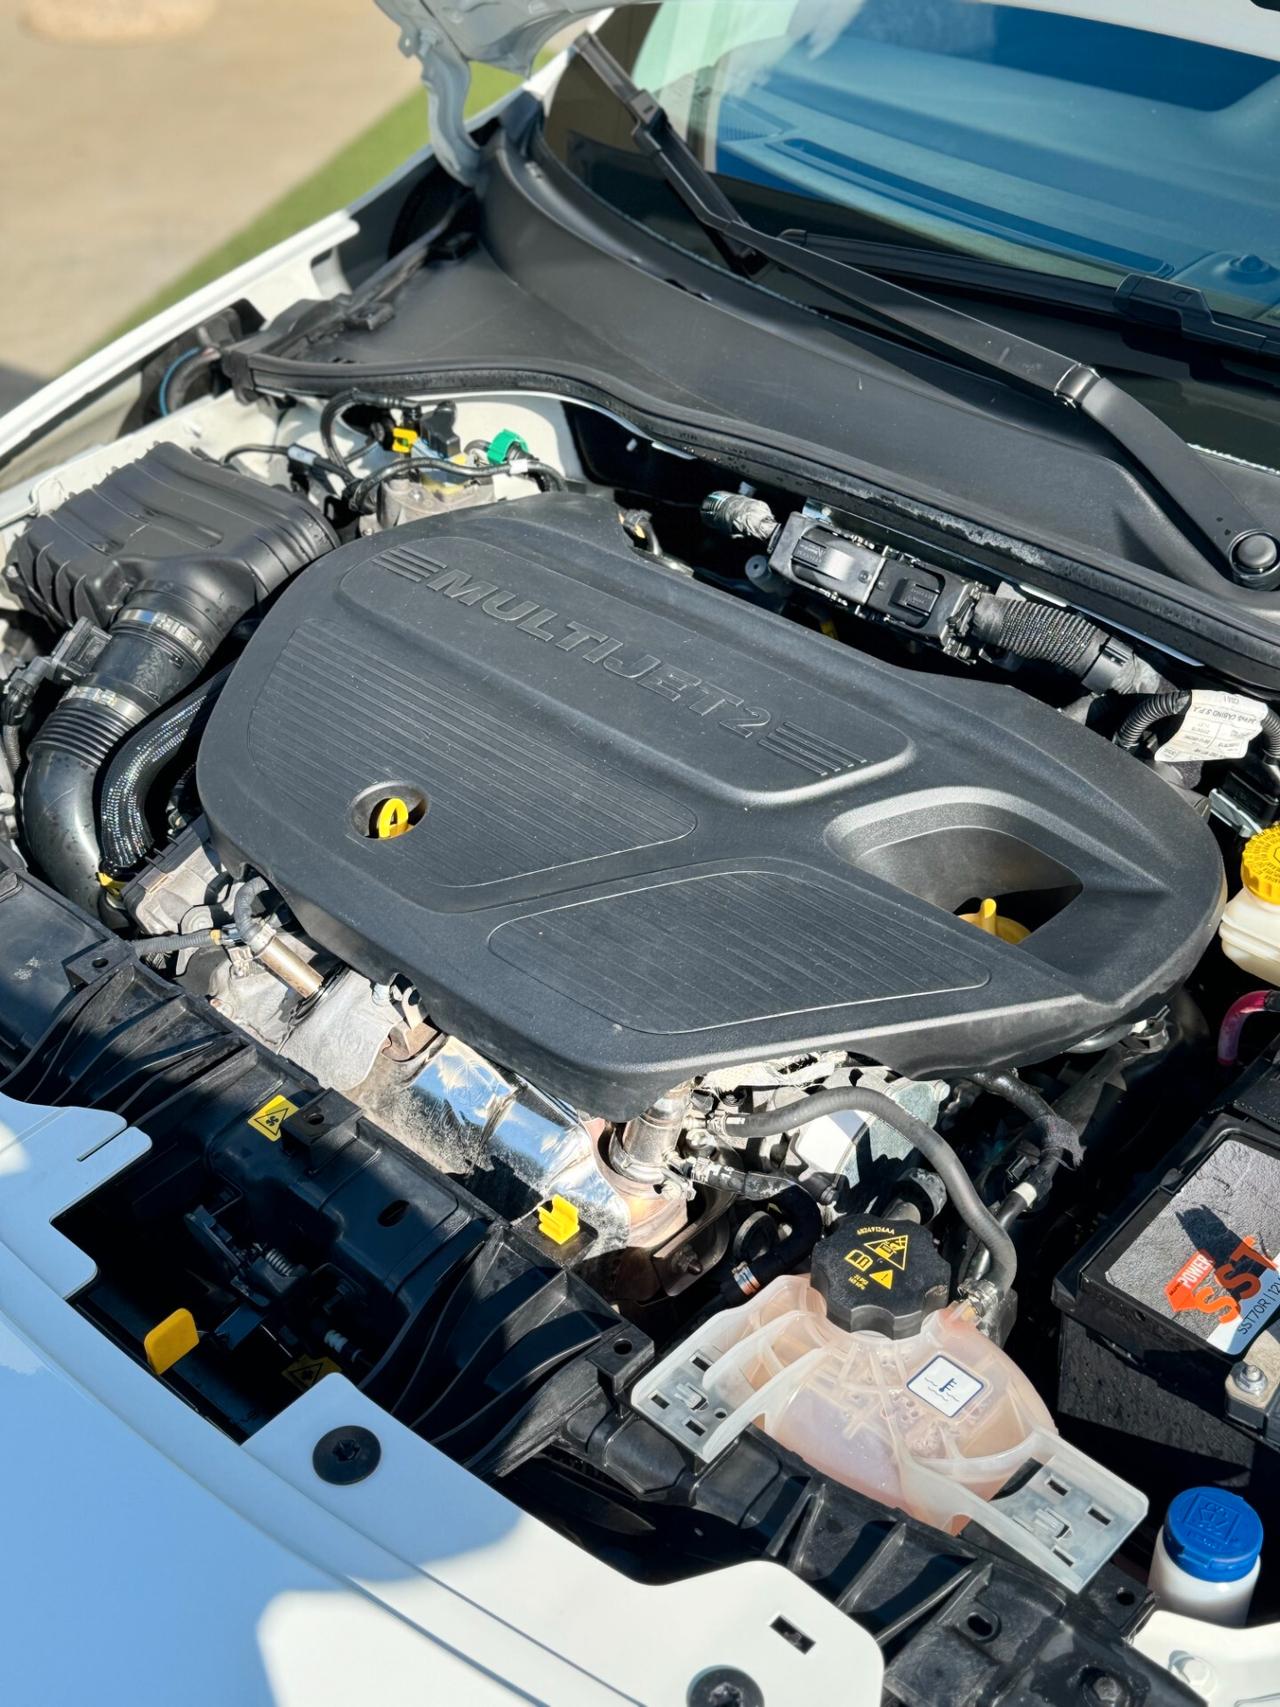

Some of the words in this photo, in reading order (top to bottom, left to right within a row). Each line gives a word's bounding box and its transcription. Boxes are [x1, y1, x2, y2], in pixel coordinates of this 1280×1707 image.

[1177, 1253, 1216, 1289] POWER
[1195, 1235, 1278, 1324] SST
[1237, 1297, 1271, 1335] SST70R
